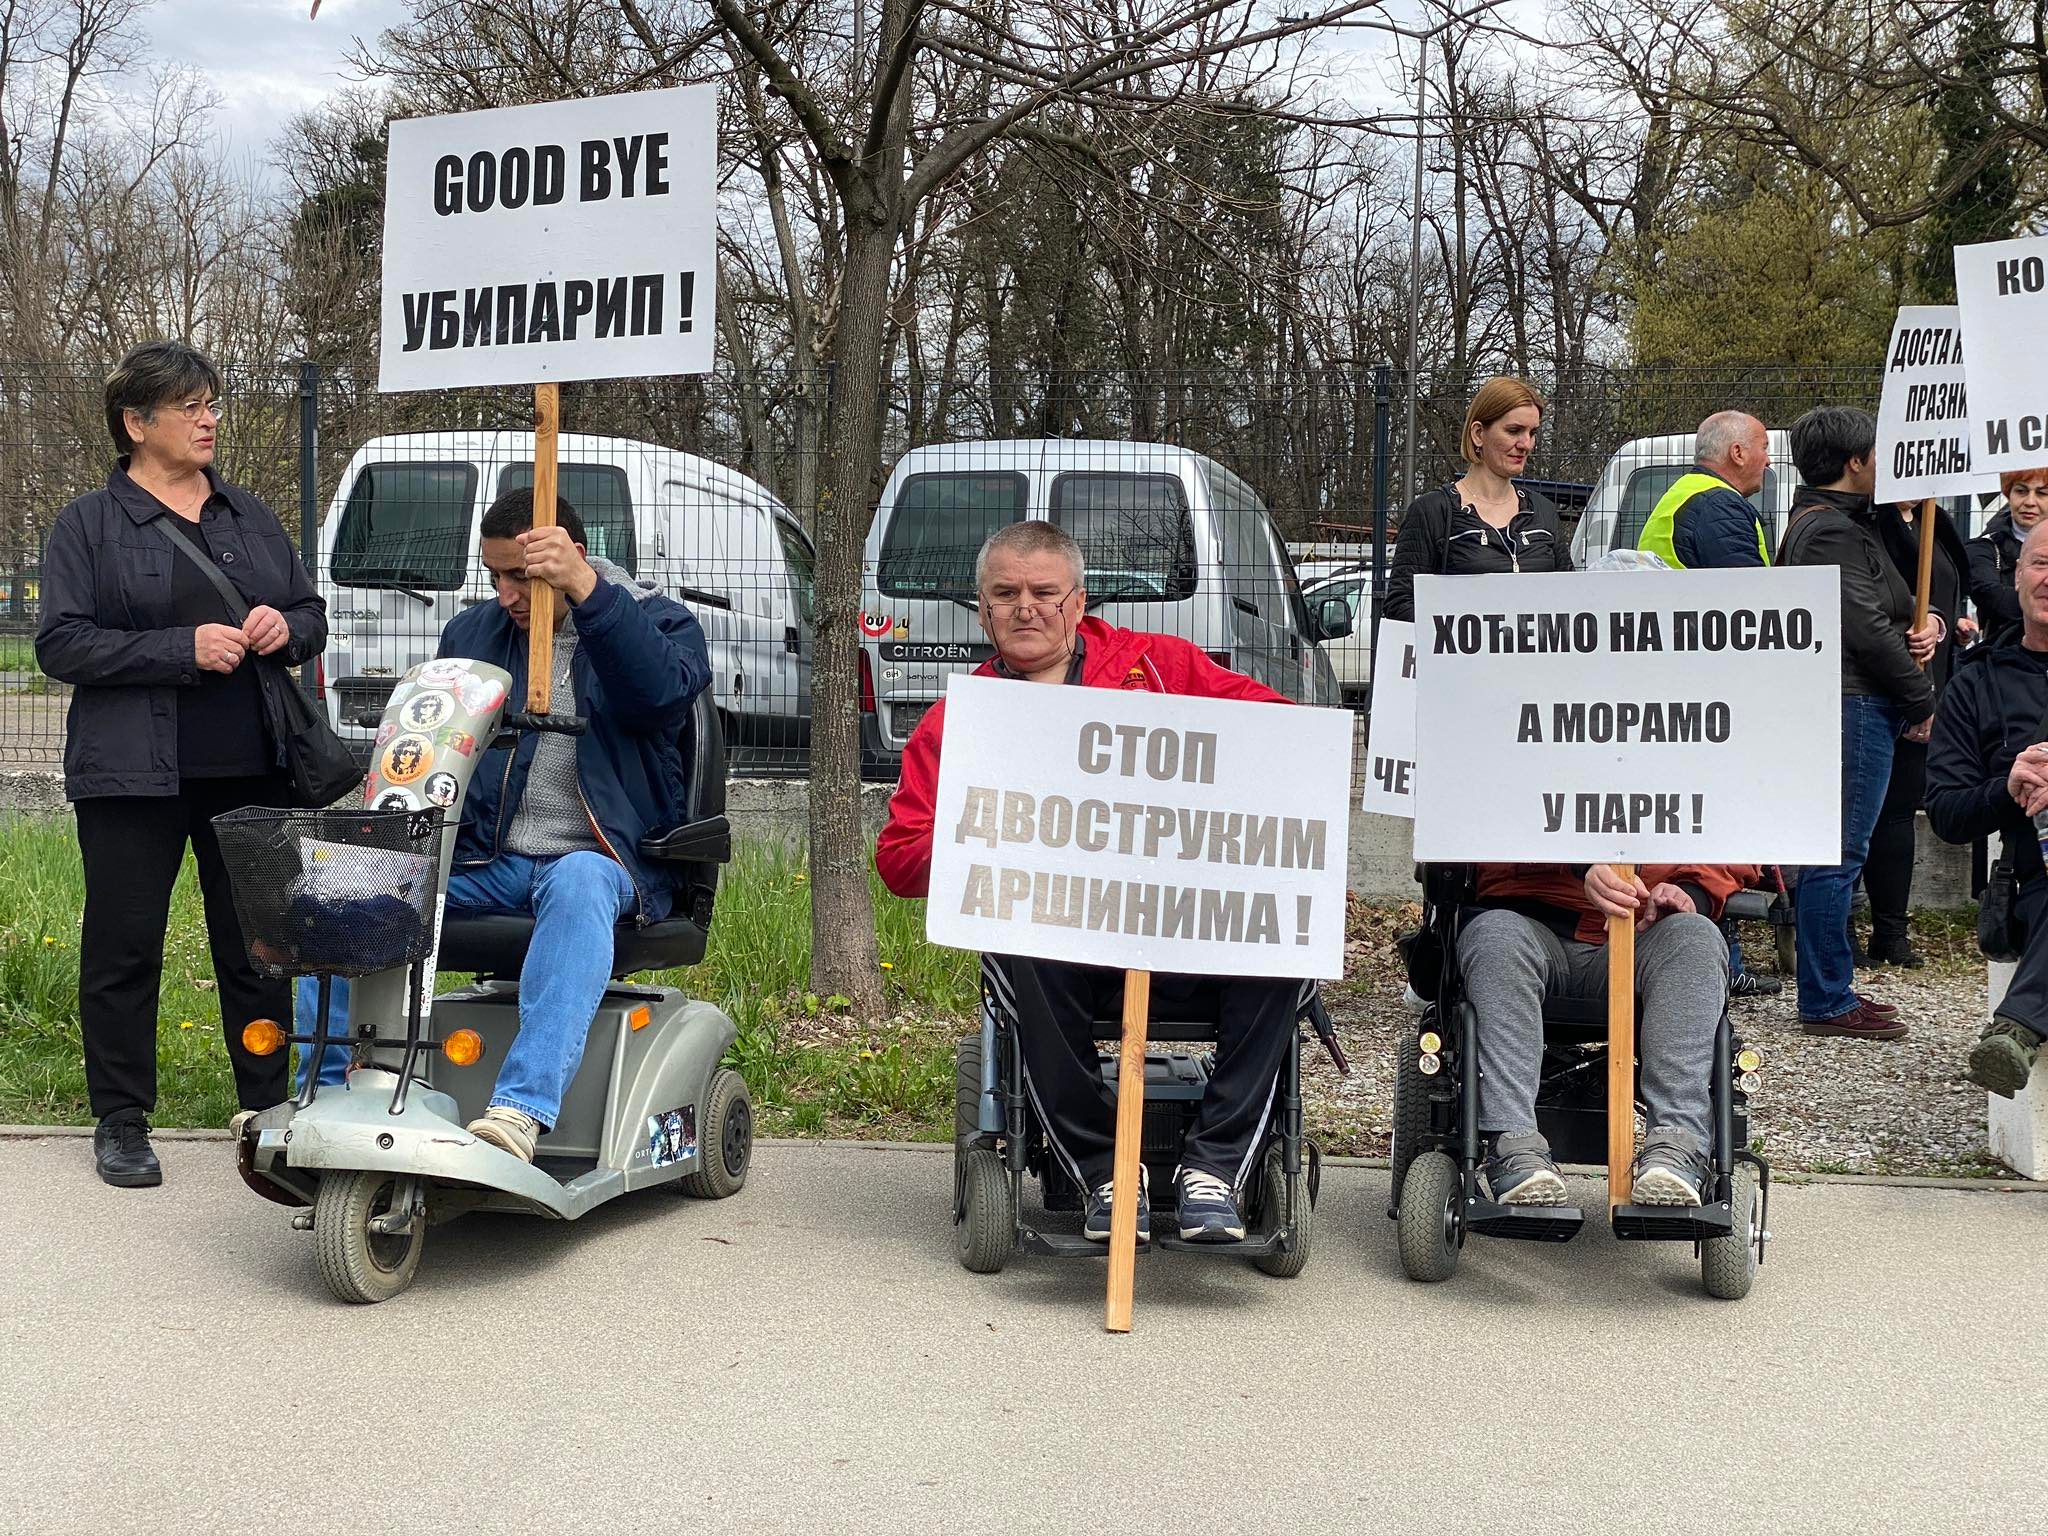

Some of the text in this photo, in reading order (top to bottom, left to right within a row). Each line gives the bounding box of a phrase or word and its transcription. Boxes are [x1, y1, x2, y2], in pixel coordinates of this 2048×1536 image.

[434, 132, 669, 216] GOOD BYE
[402, 271, 695, 352] УБИПАРИП !
[1891, 328, 1952, 373] ДОСТА
[1986, 414, 2048, 455] И С
[893, 644, 971, 658] CITROËN
[1433, 608, 1823, 655] ХОЋЕМО НА ПОСАО,
[1517, 701, 1731, 743] А МОРАМО
[1077, 721, 1218, 785] СТОП
[1374, 756, 1416, 795] ЧЕ
[954, 786, 1327, 871] ДВОСТРУКИМ
[1543, 793, 1704, 834] У ПАРК !
[960, 863, 1313, 946] АРШИНИМА !
